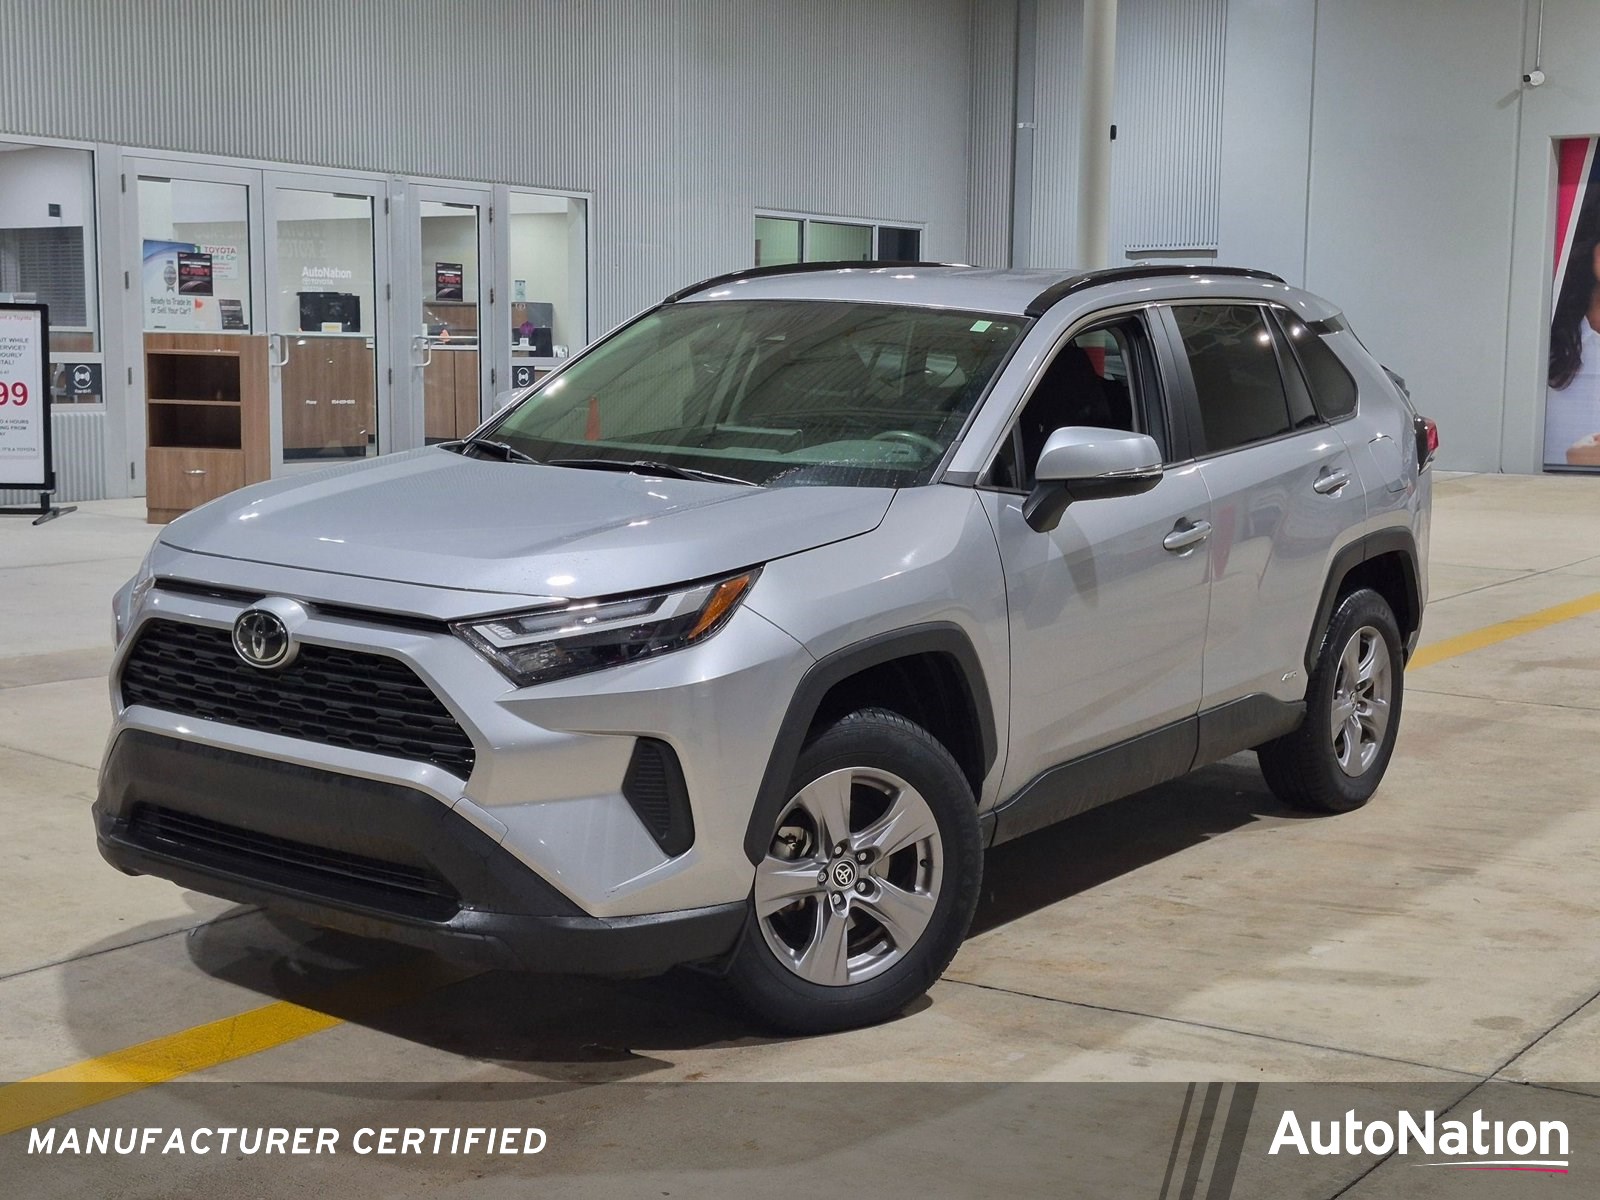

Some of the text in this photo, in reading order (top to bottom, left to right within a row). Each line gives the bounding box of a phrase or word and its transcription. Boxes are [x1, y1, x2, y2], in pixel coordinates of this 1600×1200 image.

[301, 266, 352, 279] AutoNation
[150, 297, 165, 306] Ready
[172, 298, 185, 306] Trade
[157, 306, 167, 314] Sell
[168, 307, 179, 315] Your
